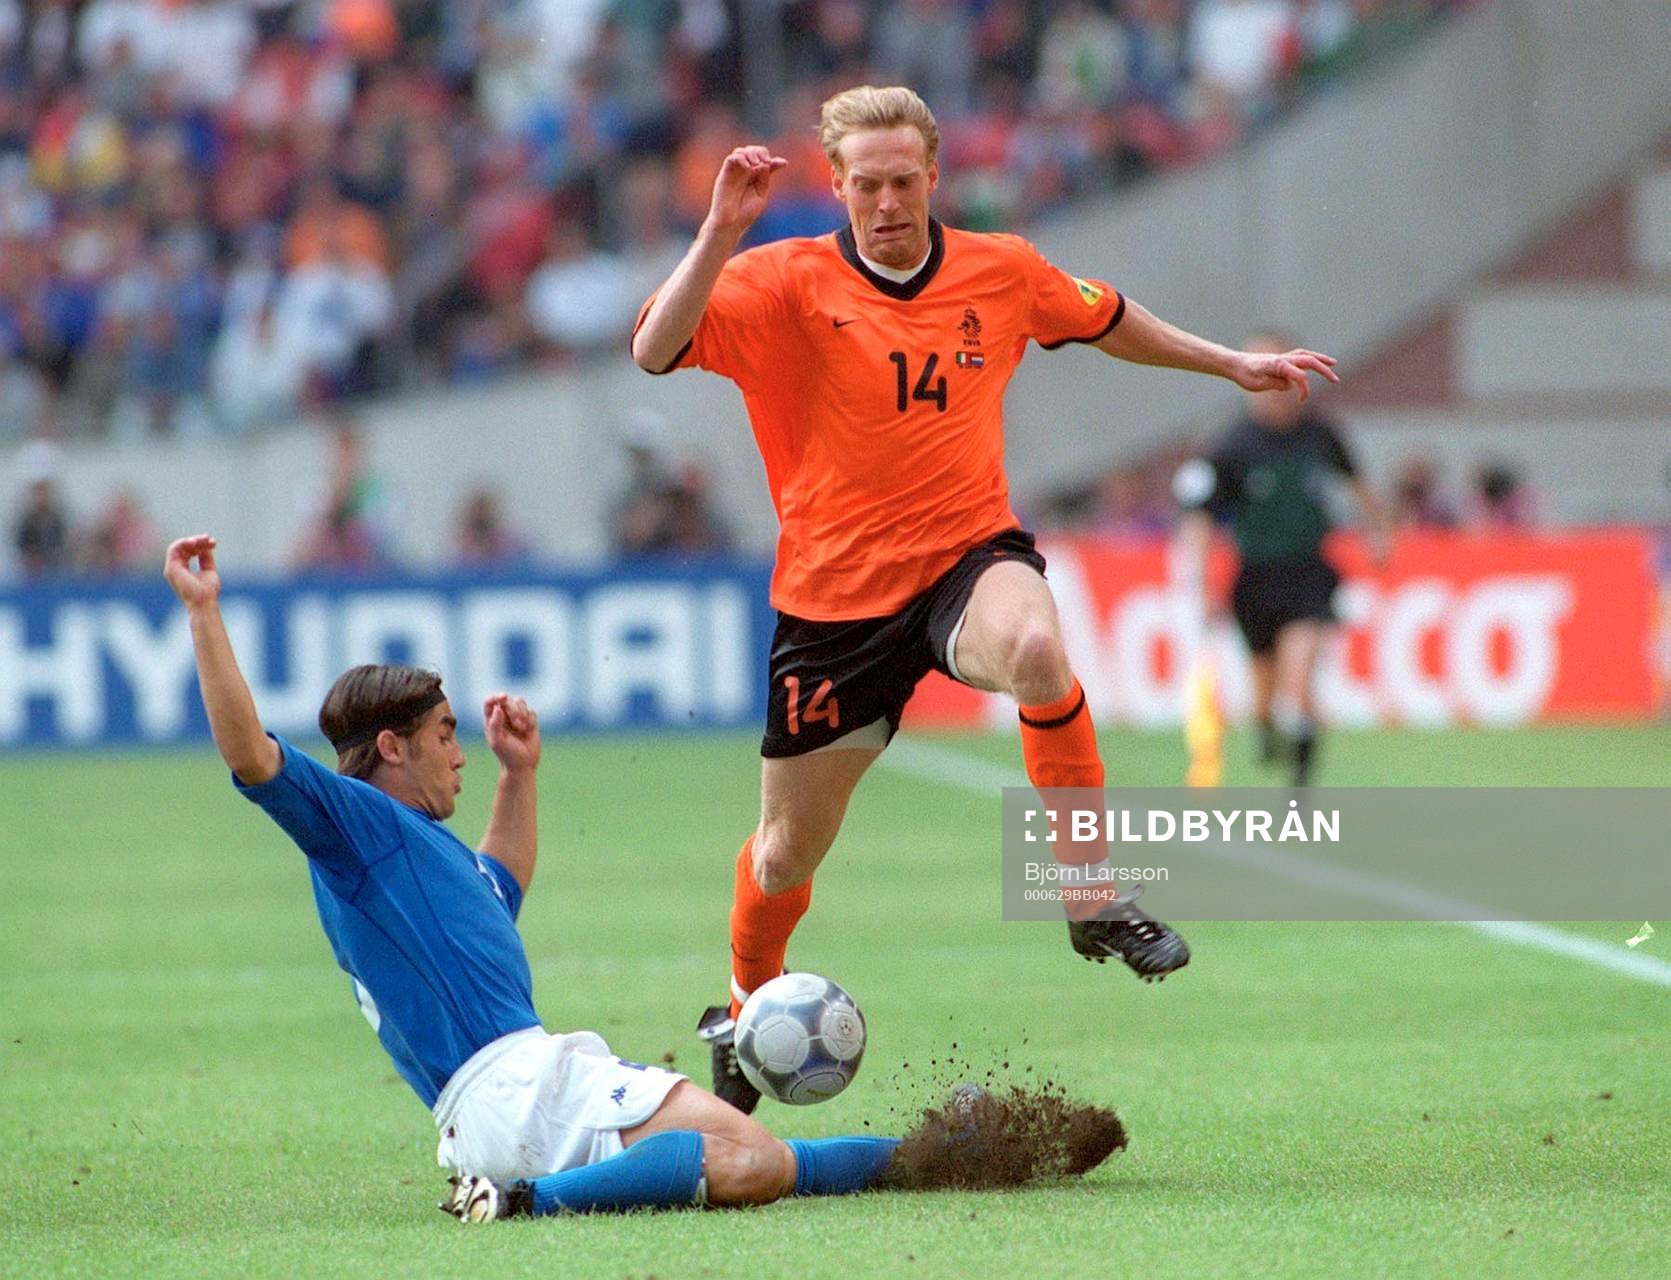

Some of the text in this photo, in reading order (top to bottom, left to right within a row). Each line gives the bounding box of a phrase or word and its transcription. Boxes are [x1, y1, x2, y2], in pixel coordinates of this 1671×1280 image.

[889, 352, 947, 412] 14
[0, 580, 752, 746] HYUNDAI
[784, 676, 839, 735] 14
